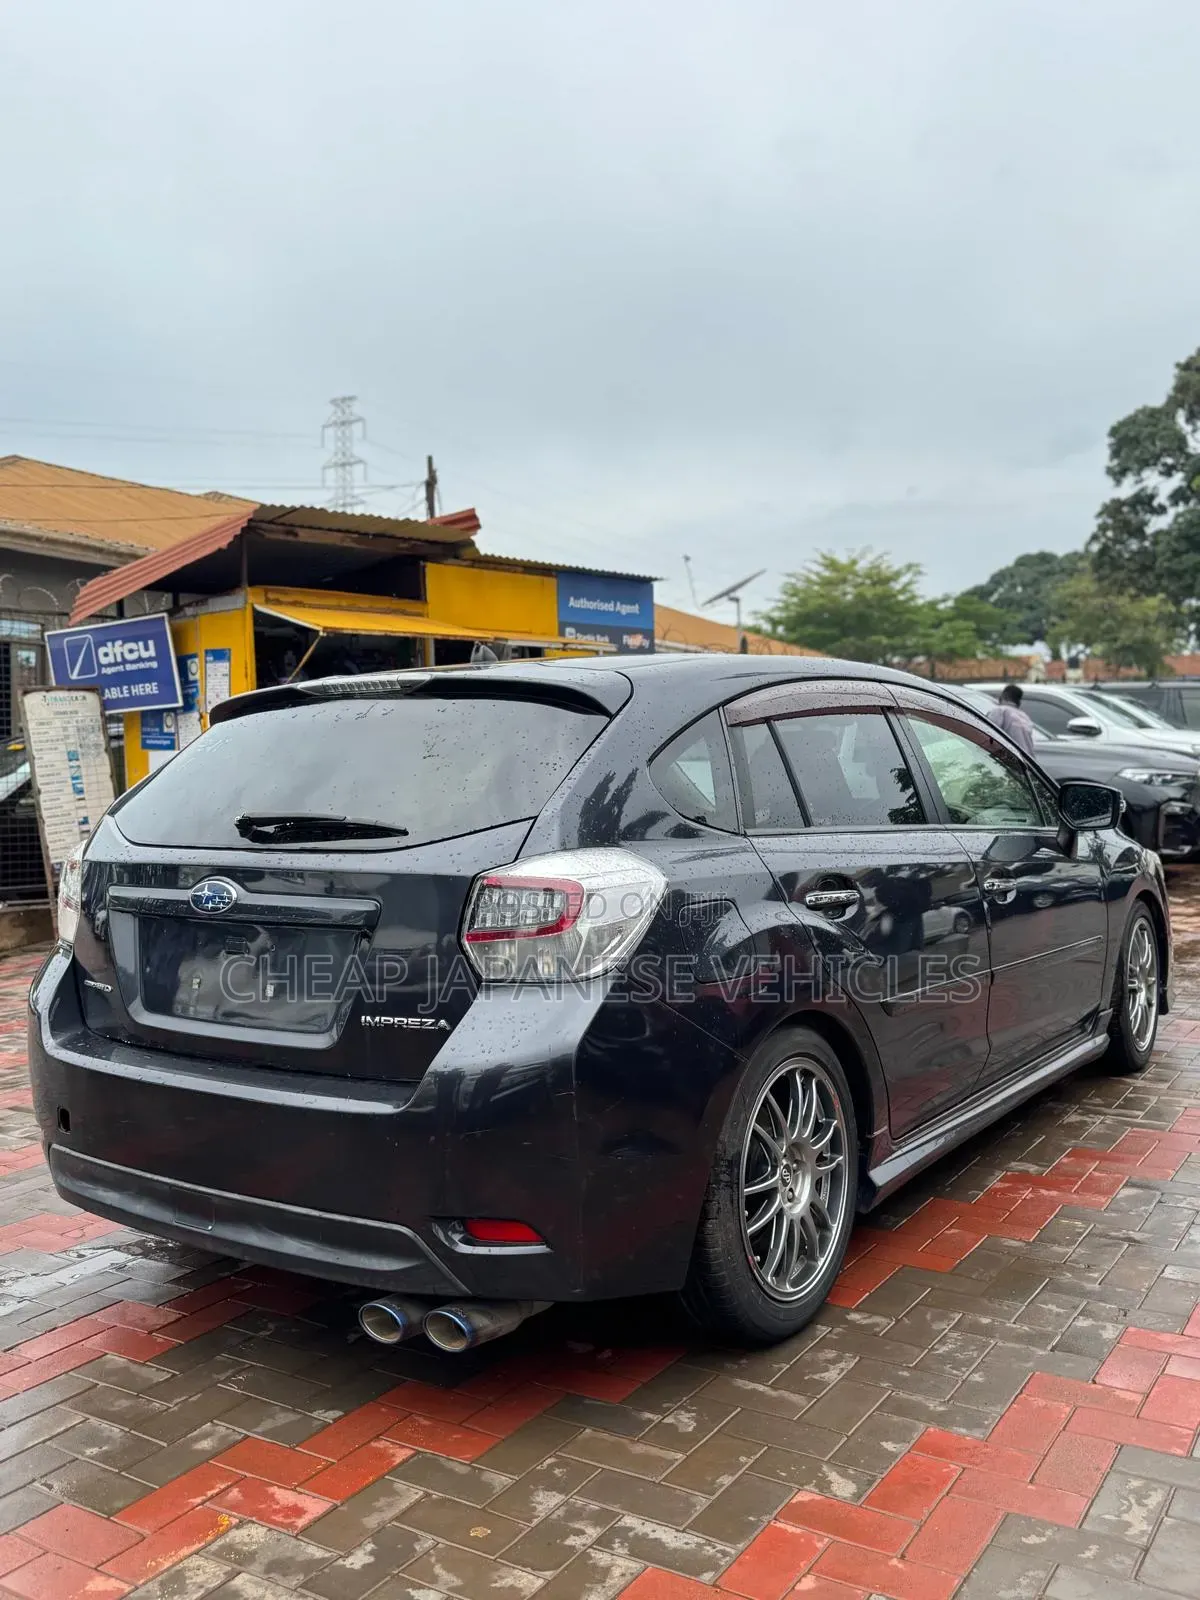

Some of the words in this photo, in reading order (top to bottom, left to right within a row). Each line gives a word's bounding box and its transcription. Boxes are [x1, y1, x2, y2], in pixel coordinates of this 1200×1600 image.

[568, 596, 614, 612] Authorised
[615, 601, 640, 615] Agent
[98, 640, 156, 665] dfcu
[101, 665, 125, 675] Agent
[125, 661, 158, 671] Banking
[131, 682, 159, 696] HERE
[361, 1015, 451, 1031] IMPREZA
